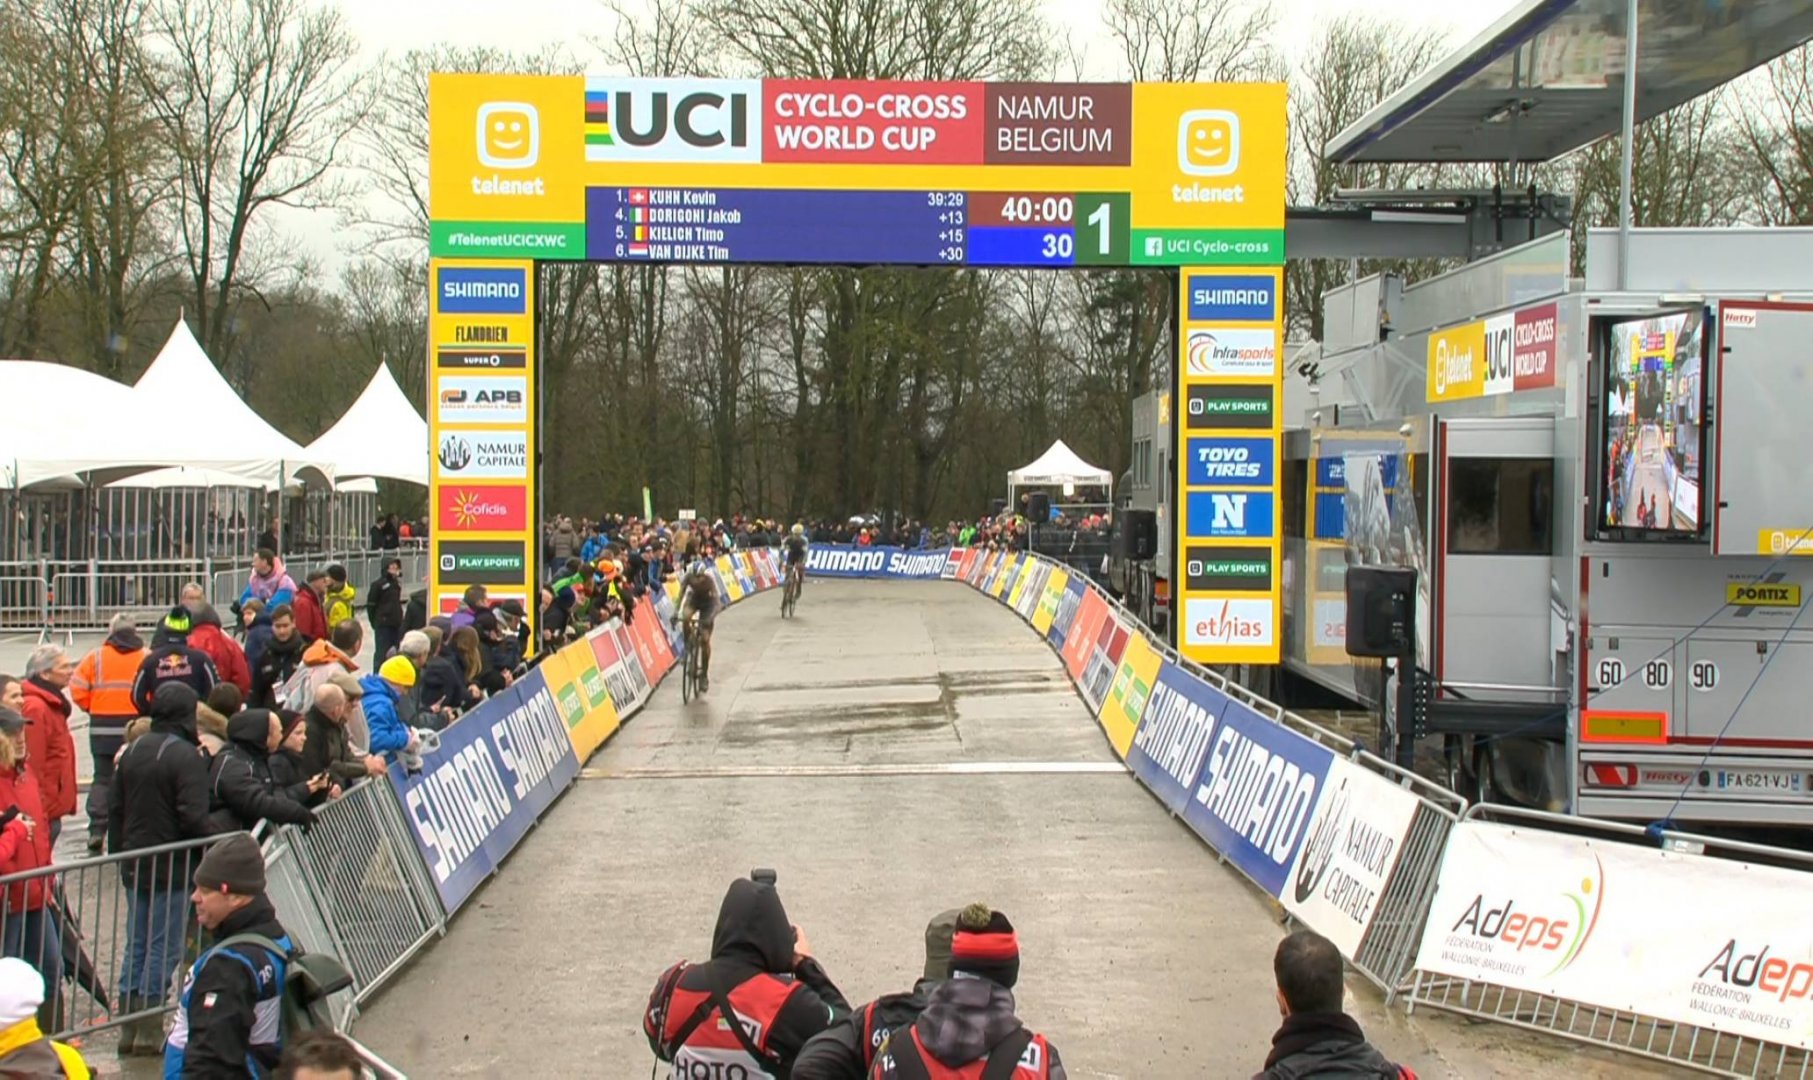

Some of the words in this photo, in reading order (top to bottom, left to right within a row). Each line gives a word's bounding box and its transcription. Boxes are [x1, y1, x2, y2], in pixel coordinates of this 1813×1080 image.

[775, 93, 967, 120] CYCLO-CROSS
[998, 95, 1094, 120] NAMUR
[615, 91, 747, 148] UCI
[775, 125, 874, 151] WORLD
[881, 126, 937, 152] CUP
[998, 127, 1113, 153] BELGIUM
[471, 174, 545, 195] telenet
[1172, 182, 1244, 203] telenet
[616, 189, 628, 203] 1.
[649, 190, 681, 205] KUHN
[683, 191, 717, 206] Kevin
[927, 192, 964, 207] 39:29
[1001, 196, 1074, 223] 40:00
[615, 207, 628, 221] 4.
[649, 208, 705, 223] DORIGONI
[707, 209, 742, 224] Jakob
[939, 211, 964, 225] +13
[1088, 202, 1110, 255] 1
[448, 233, 567, 248] #TelenetUCICXWC
[615, 226, 628, 240] 5.
[649, 227, 693, 242] KIELICH
[695, 227, 724, 242] Timo
[939, 229, 964, 243] +15
[1042, 234, 1073, 259] 30
[615, 244, 628, 258] 6.
[649, 245, 672, 260] VAN
[674, 245, 706, 260] DIJKE
[707, 245, 729, 260] Tim
[939, 247, 963, 262] +30
[1167, 239, 1190, 253] UCI
[1193, 239, 1270, 257] Cyclo-cross
[444, 282, 520, 298] SHIMANO
[1194, 289, 1269, 305] SHIMANO
[455, 325, 508, 343] FLANDRIEN
[1515, 317, 1554, 347] CYCLO-CROSS
[464, 357, 489, 365] SUPER
[1212, 345, 1274, 361] Infrasports
[1446, 342, 1473, 385] telenet
[1488, 327, 1512, 381] UCI
[1515, 351, 1535, 377] WORLD
[1535, 350, 1547, 373] CUP
[475, 389, 522, 403] APB
[1207, 402, 1230, 411] PLAY
[1232, 402, 1268, 411] SPORTS
[477, 443, 526, 455] NAMUR
[477, 455, 526, 467] CAPITALE
[1198, 448, 1249, 462] TOYO
[1206, 463, 1261, 477] TIRES
[463, 502, 508, 516] Cofidis
[1211, 494, 1247, 528] N
[459, 558, 484, 568] PLAY
[484, 558, 520, 568] SPORTS
[805, 550, 885, 571] HIMANO
[887, 552, 946, 576] SHIMANO
[1206, 564, 1230, 573] PLAY
[1231, 564, 1267, 573] SPORTS
[1736, 587, 1789, 601] PORTIX
[1196, 600, 1262, 644] ethias
[1600, 661, 1622, 686] 60
[1646, 661, 1668, 687] 80
[1693, 663, 1715, 688] 90
[1134, 681, 1216, 790] SHIMANO
[406, 736, 512, 885] SHIMANO
[491, 686, 569, 801] SHIMANO
[1196, 724, 1317, 867] SHIMANO
[1342, 816, 1394, 879] NAMUR
[1324, 866, 1375, 926] CAPITALE
[1452, 894, 1569, 952] Adeps
[1689, 999, 1792, 1030] WALLONIE-BRUXELLES
